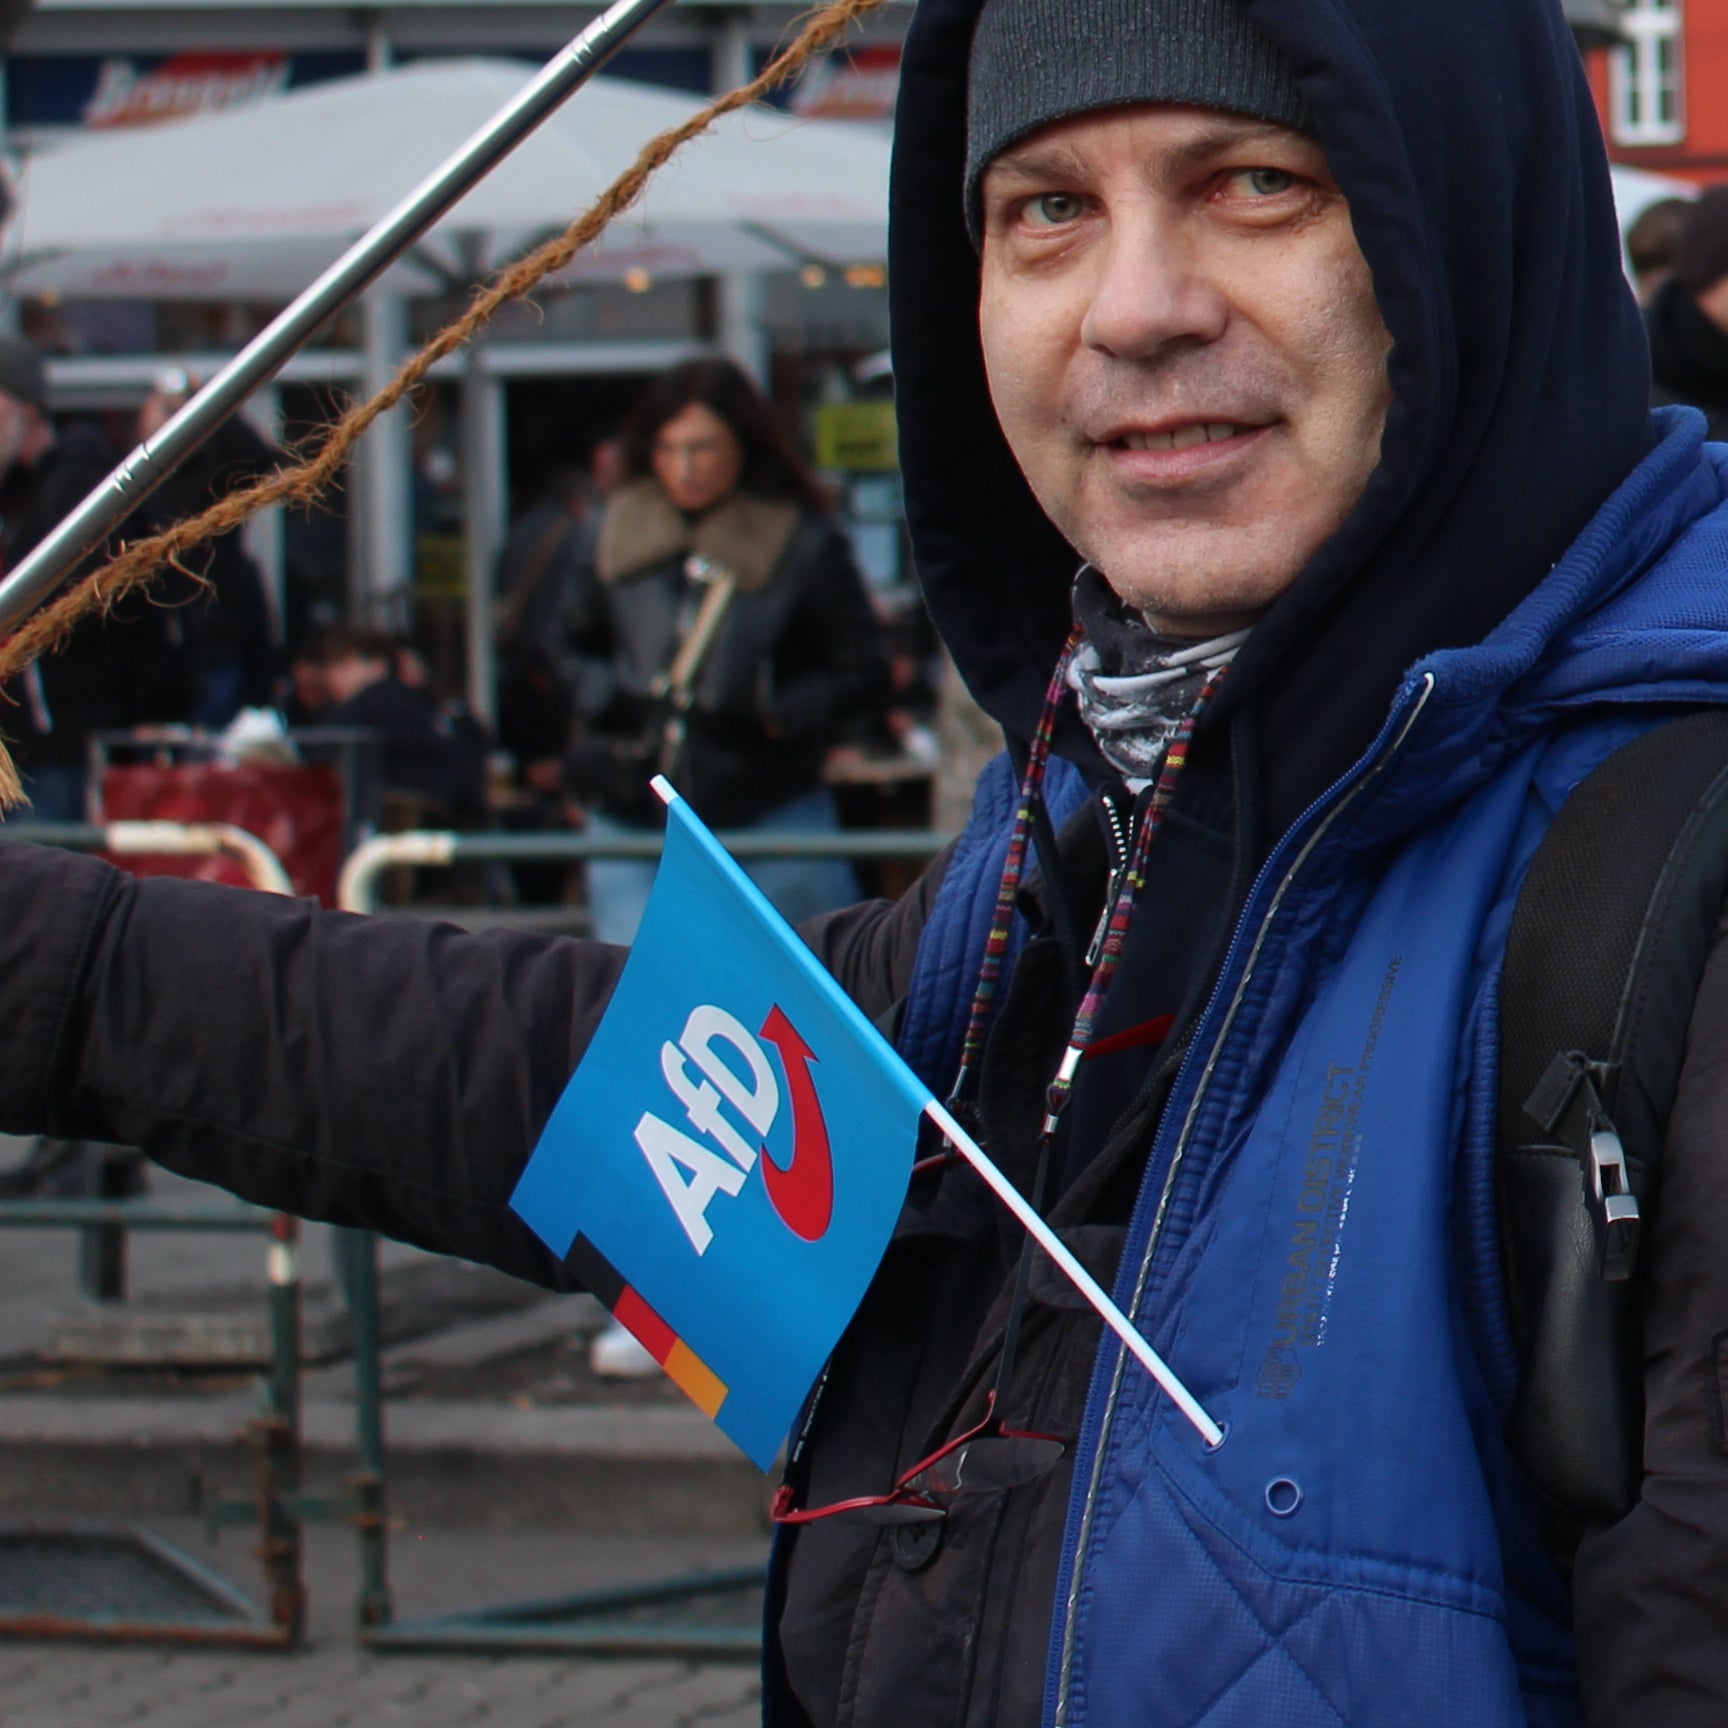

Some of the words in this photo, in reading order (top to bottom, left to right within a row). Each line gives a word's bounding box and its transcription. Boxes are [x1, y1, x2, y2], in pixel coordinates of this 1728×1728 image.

[633, 1005, 780, 1257] AfD
[1272, 1220, 1320, 1347] URBAN
[1296, 1058, 1354, 1214] DISTRICT
